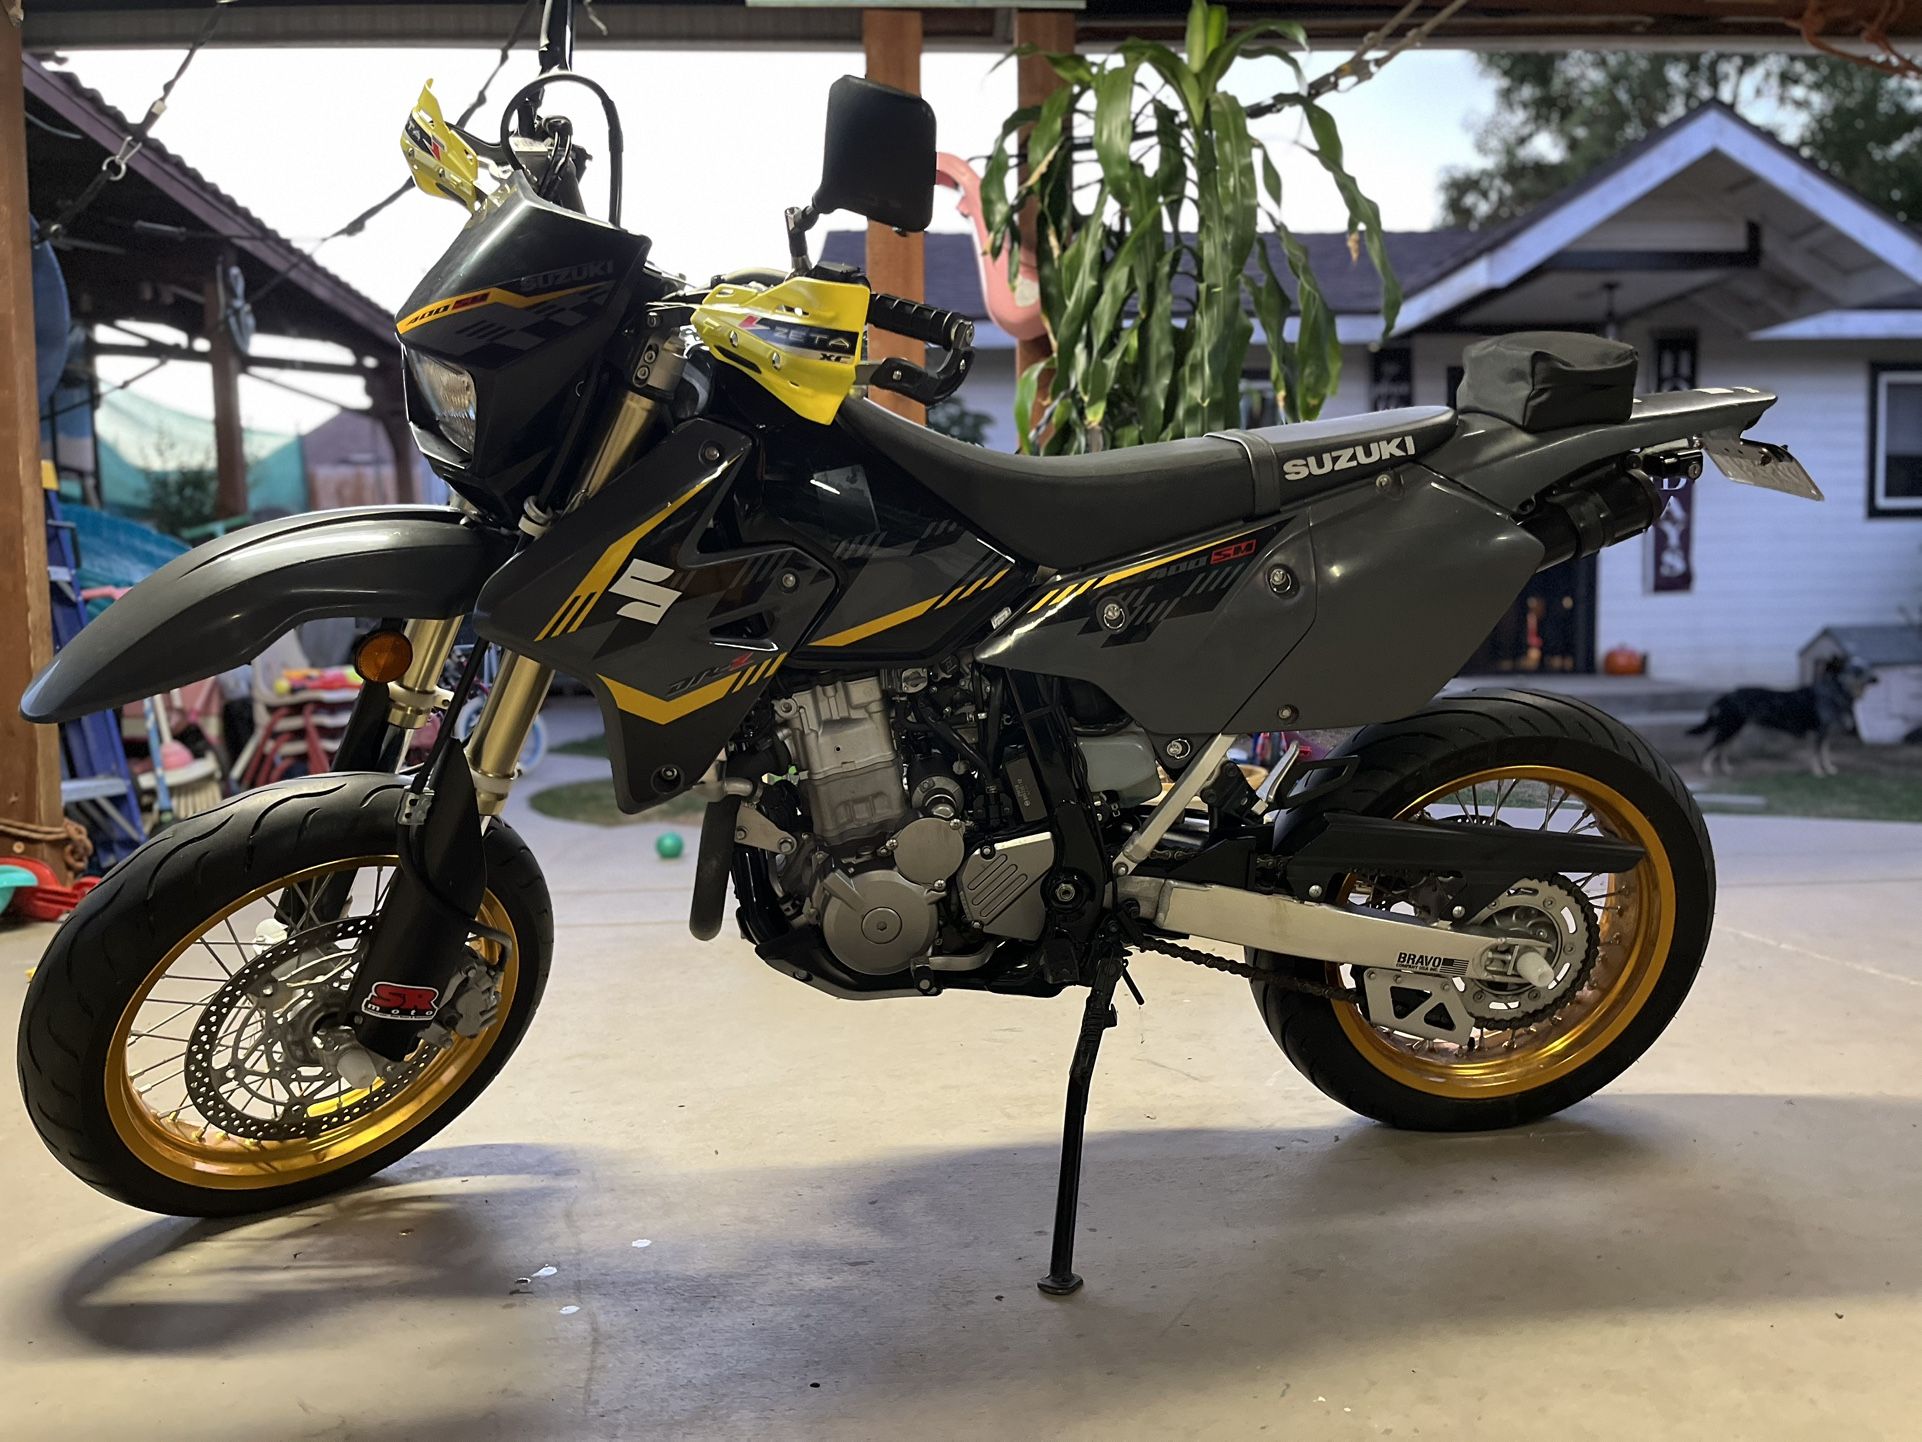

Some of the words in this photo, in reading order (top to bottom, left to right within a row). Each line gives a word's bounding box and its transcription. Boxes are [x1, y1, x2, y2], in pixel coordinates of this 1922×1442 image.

[773, 325, 850, 349] ZETA
[1282, 435, 1416, 481] SUZUKI
[1397, 952, 1441, 968] BRAVO
[371, 984, 434, 1009] SR
[367, 1003, 433, 1016] moto
